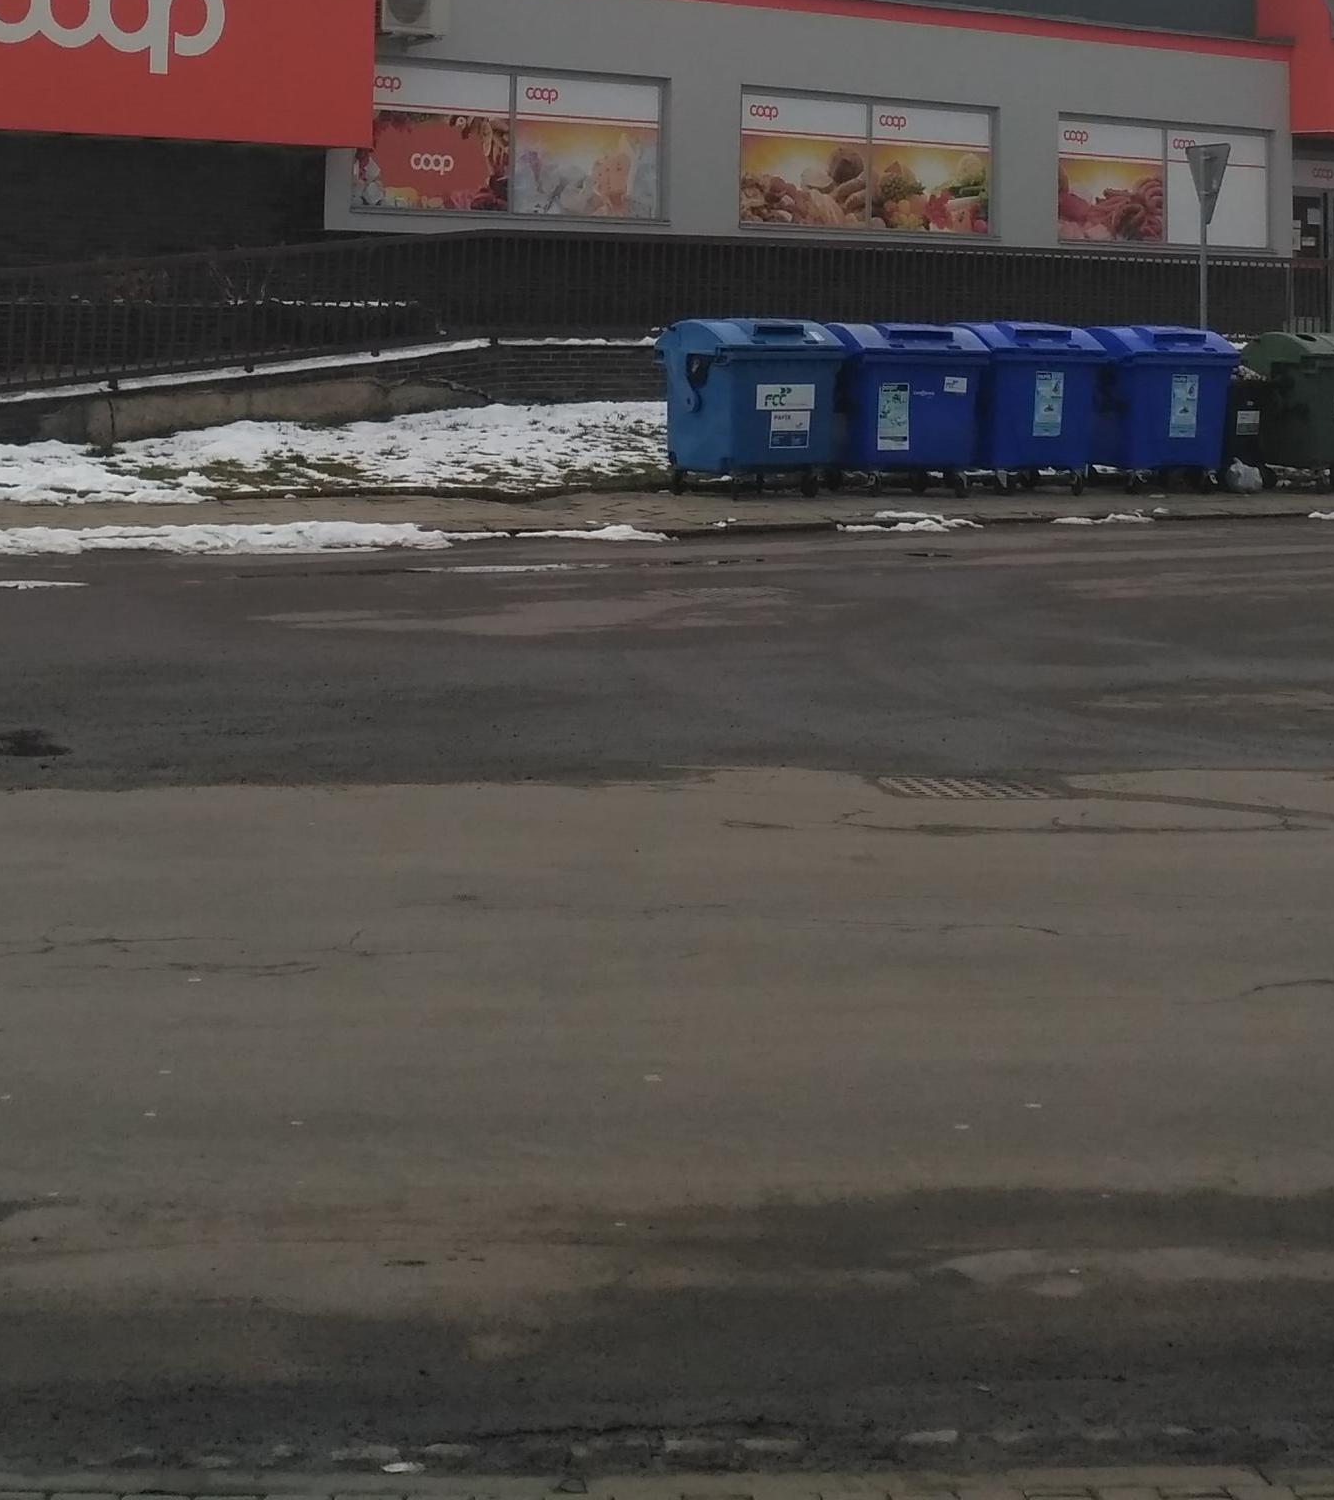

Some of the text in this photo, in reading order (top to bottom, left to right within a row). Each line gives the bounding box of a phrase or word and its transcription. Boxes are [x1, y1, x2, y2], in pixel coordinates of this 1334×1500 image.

[373, 75, 402, 93] oop
[525, 87, 559, 105] coop
[749, 104, 779, 121] coop
[879, 113, 907, 131] coop
[1063, 130, 1089, 145] coop
[410, 152, 455, 176] coop
[764, 394, 787, 407] FCC
